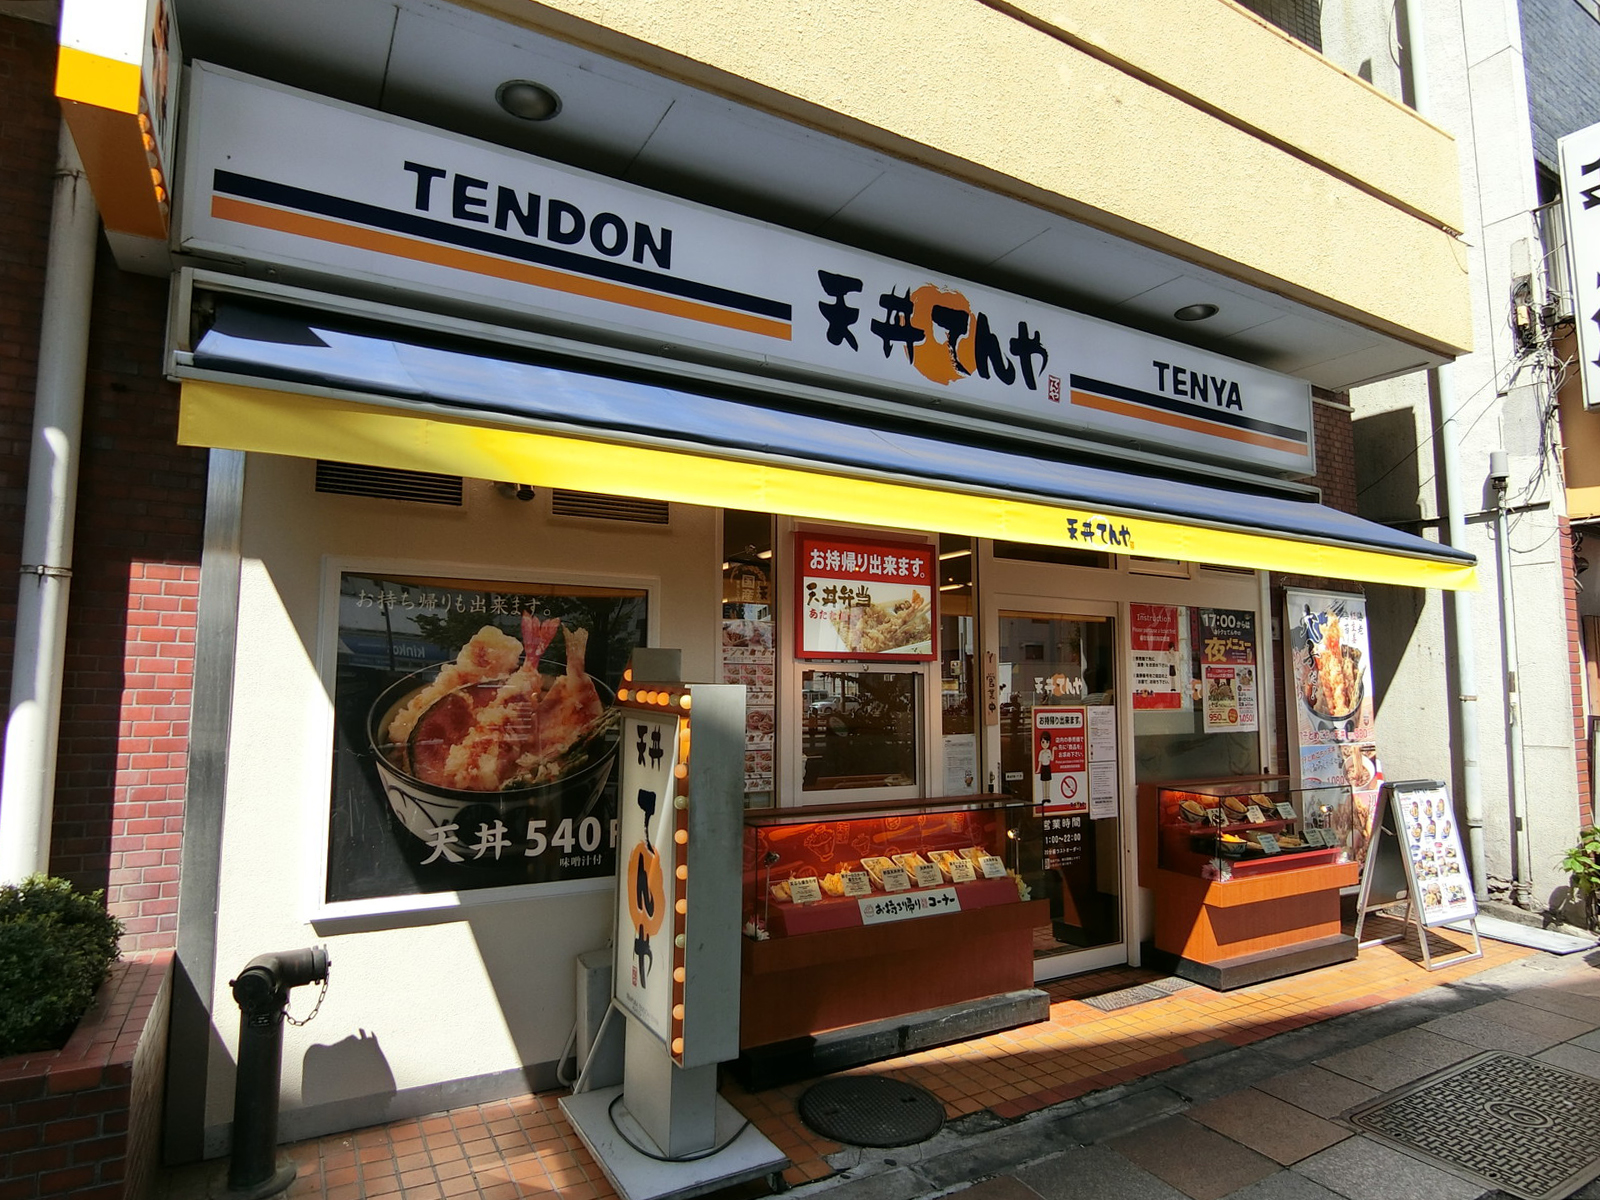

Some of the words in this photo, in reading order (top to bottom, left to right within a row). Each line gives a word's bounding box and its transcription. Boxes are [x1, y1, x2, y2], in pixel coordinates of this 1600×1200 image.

[403, 160, 672, 270] TENDON
[818, 269, 1048, 390] 天丼てんや
[1153, 360, 1243, 411] TENYA
[1066, 518, 1132, 547] 天丼てんや
[809, 548, 926, 578] お持帰り出来ます。
[355, 588, 552, 617] お持ち帰りも出来ます。
[1203, 613, 1236, 628] 17:00
[1034, 676, 1083, 697] 天丼てんや
[420, 818, 512, 865] 天丼
[928, 893, 955, 907] コーナー
